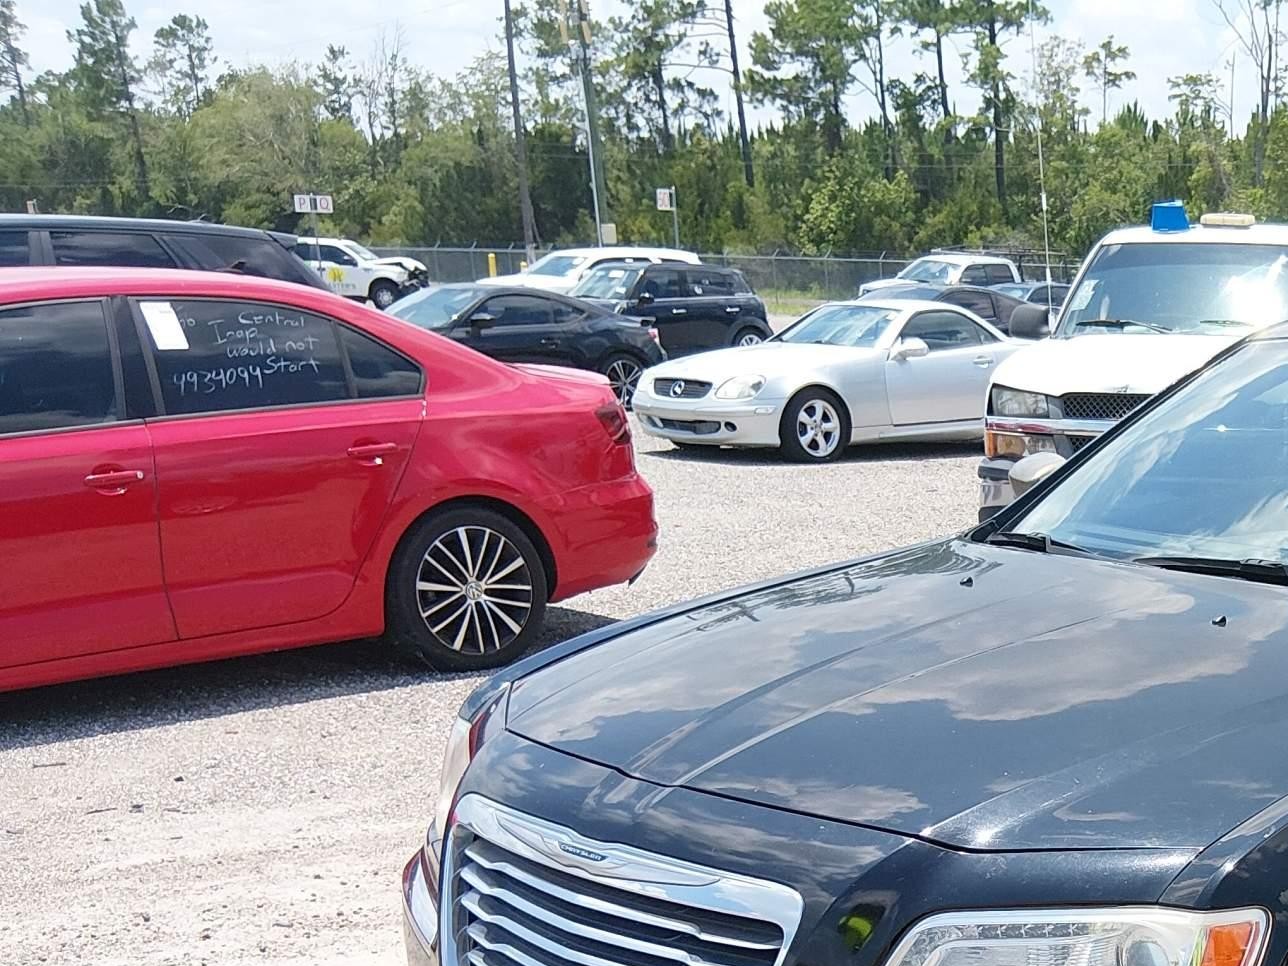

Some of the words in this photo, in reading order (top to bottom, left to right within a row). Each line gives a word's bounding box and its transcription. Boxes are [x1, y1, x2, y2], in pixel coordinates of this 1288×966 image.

[298, 197, 306, 209] P
[226, 339, 277, 358] would
[285, 335, 320, 352] not
[263, 356, 321, 374] Start
[174, 365, 264, 396] 4934094
